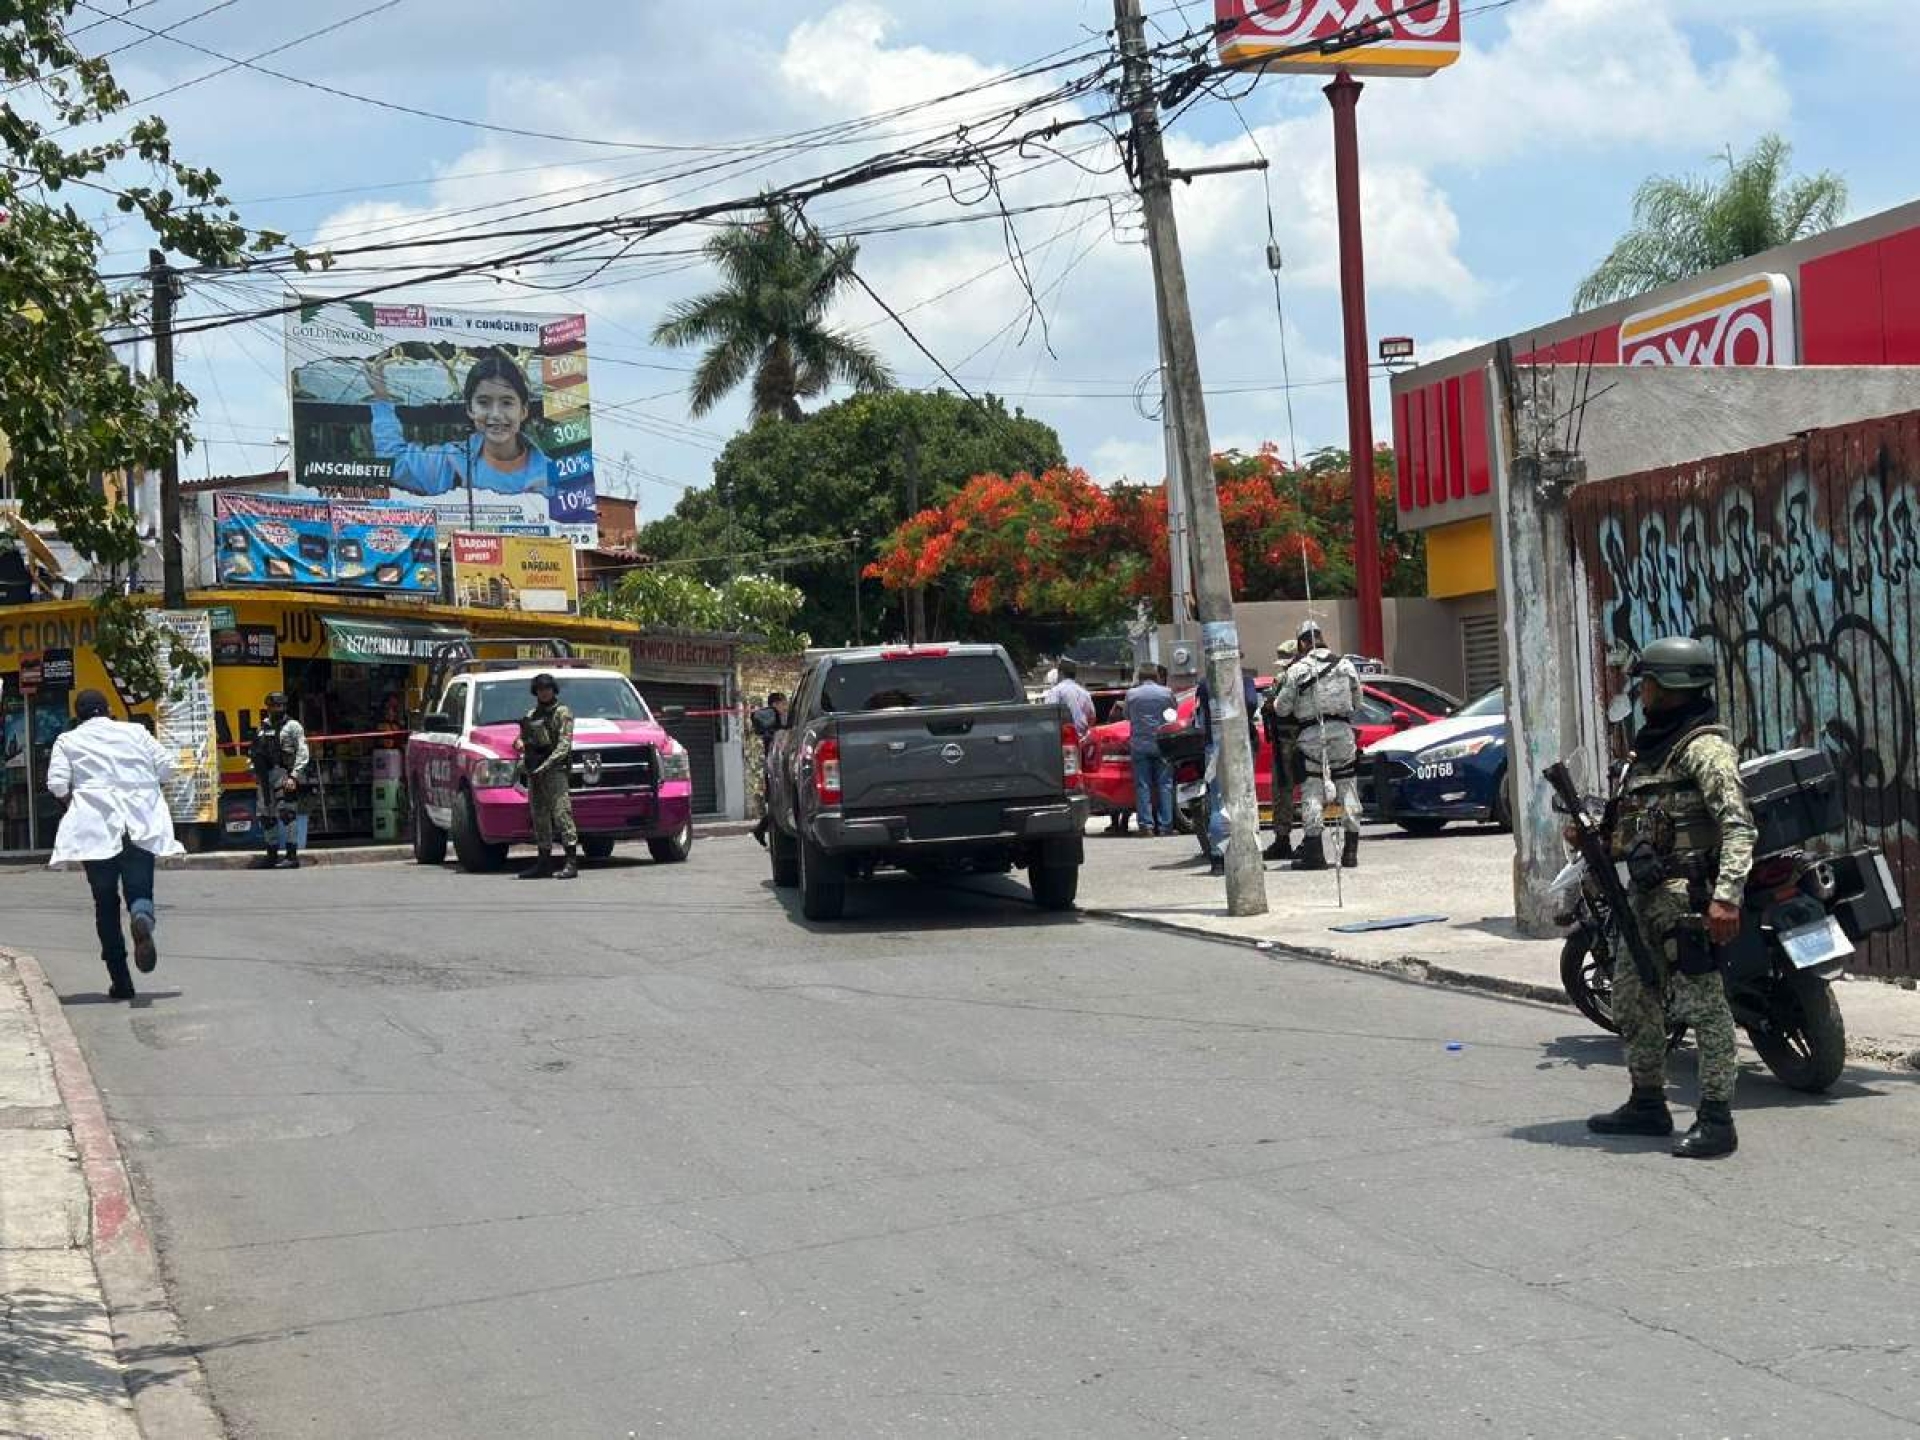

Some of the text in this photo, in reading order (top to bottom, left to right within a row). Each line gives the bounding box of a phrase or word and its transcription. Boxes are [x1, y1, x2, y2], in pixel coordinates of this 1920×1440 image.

[466, 319, 473, 328] Y
[553, 423, 589, 443] 30%
[304, 460, 391, 478] ¡INSCRÍBETE!
[556, 455, 590, 476] 20%
[557, 489, 592, 511] 10%
[1417, 762, 1454, 779] 00768
